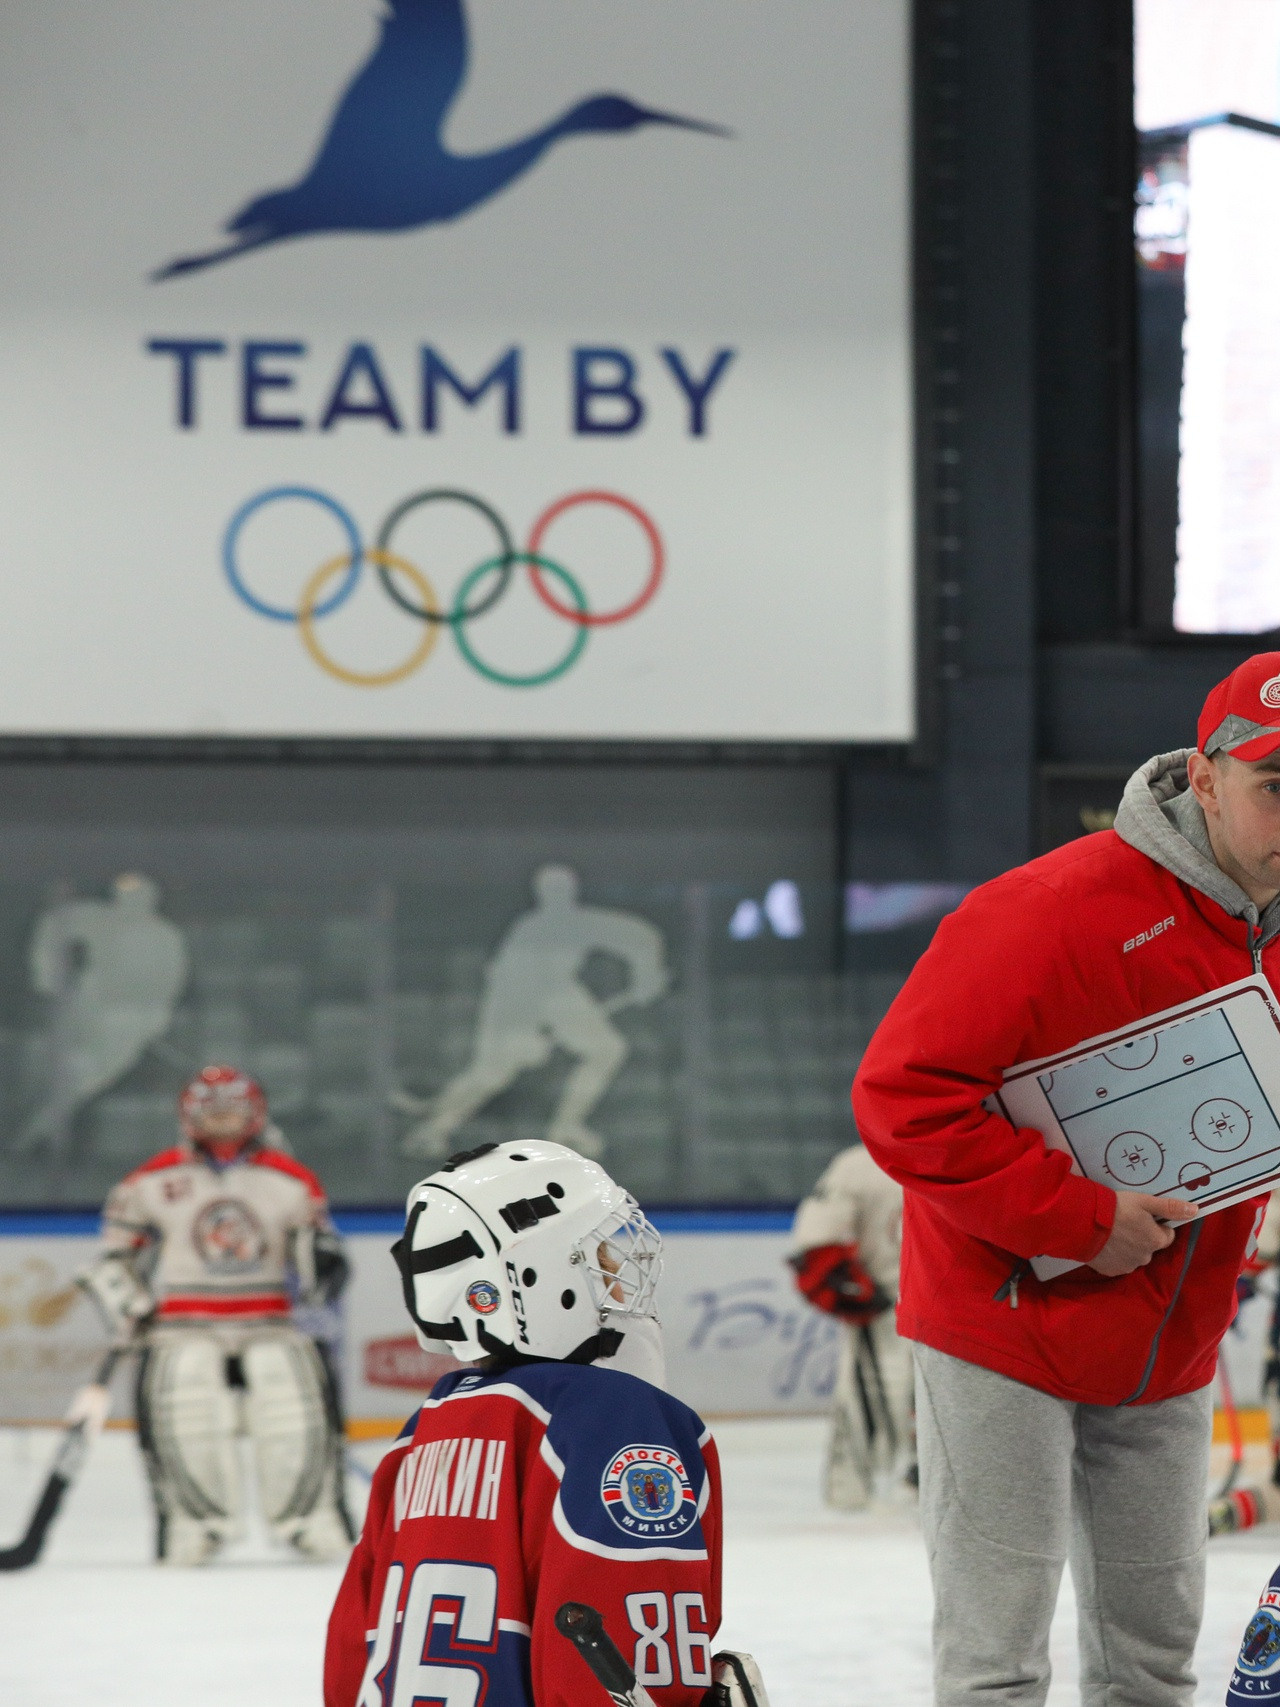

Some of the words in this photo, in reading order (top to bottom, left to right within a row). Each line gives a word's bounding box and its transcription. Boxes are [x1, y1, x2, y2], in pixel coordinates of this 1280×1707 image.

[147, 338, 524, 436] TEAM
[571, 346, 738, 439] BY
[1123, 915, 1176, 954] BAUER
[505, 1260, 529, 1346] CCM
[611, 1449, 685, 1476] ЮНОСТЬ
[621, 1514, 688, 1532] МИНСК
[625, 1590, 712, 1687] 86
